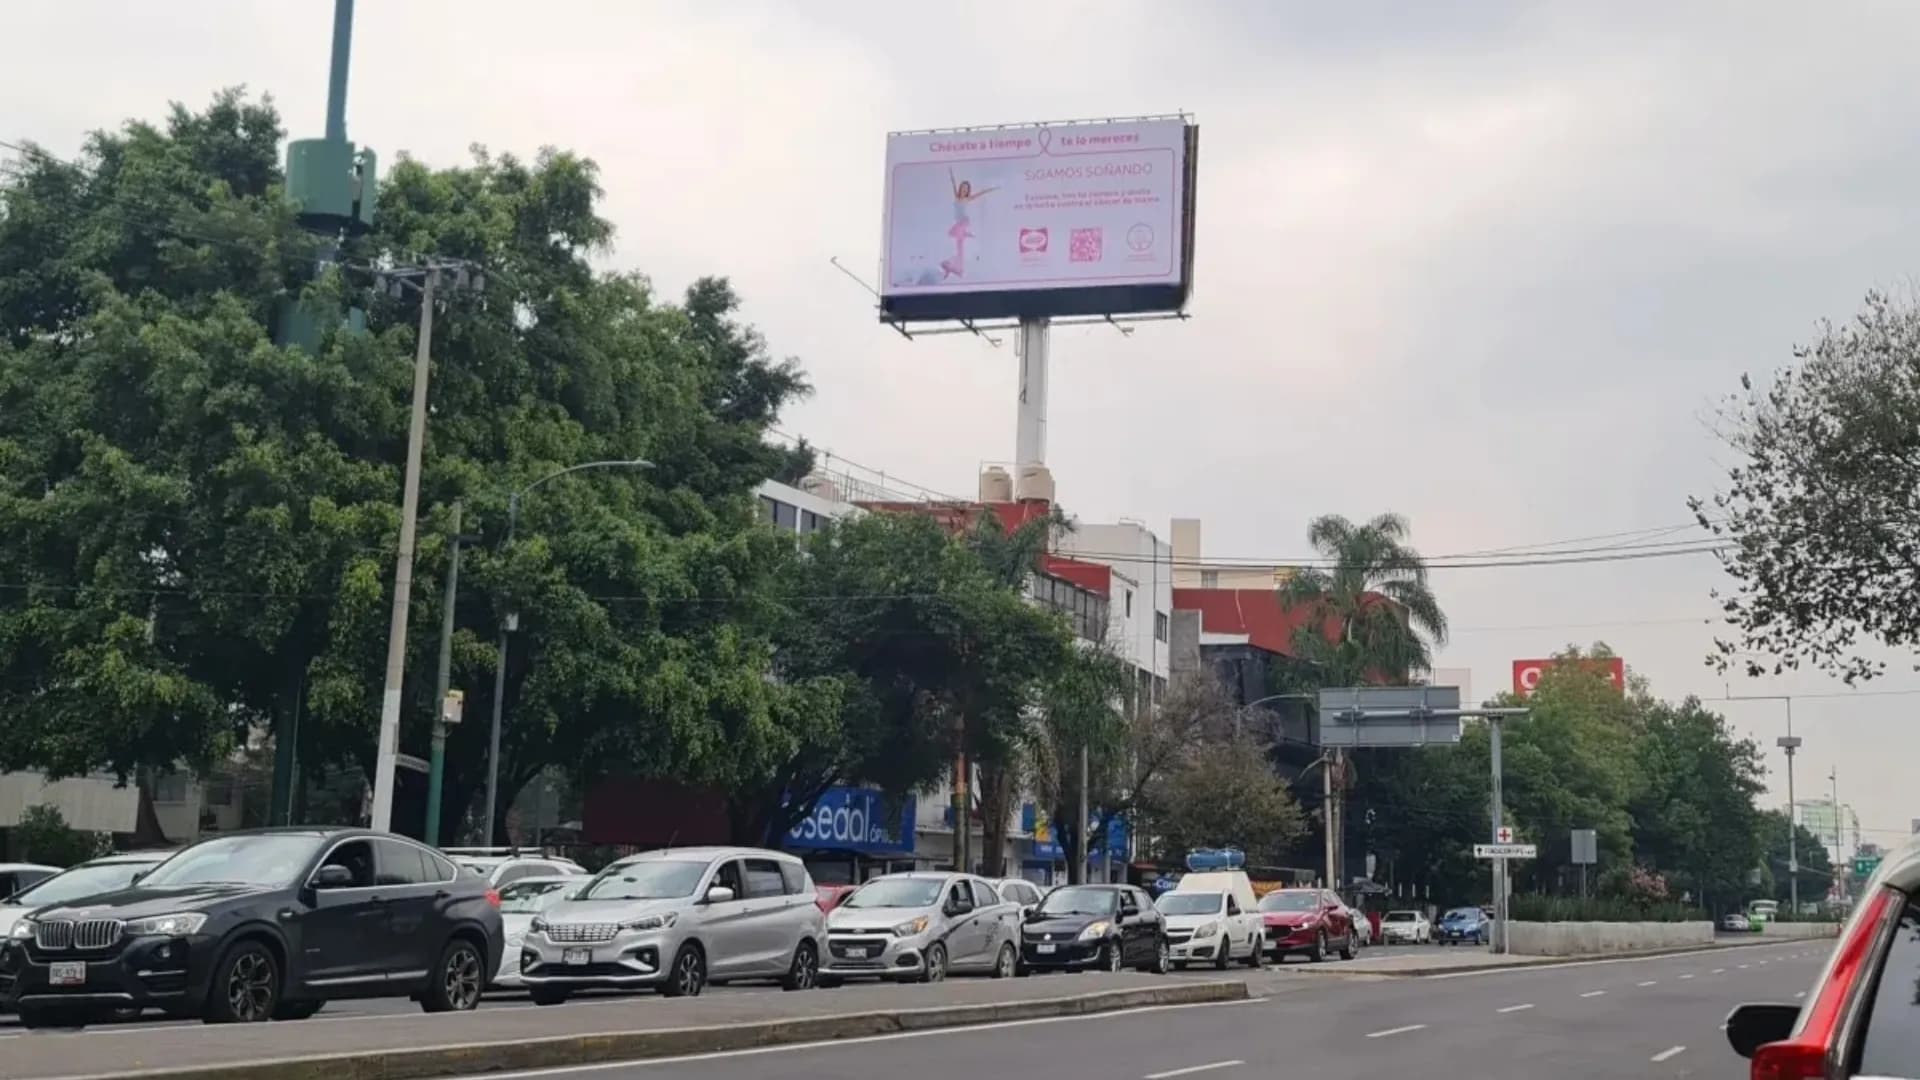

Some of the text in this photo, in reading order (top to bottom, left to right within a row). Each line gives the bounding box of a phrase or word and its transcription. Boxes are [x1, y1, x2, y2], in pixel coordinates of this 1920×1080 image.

[989, 138, 1032, 151] tiempo
[1061, 135, 1073, 145] te
[1089, 132, 1139, 144] mereces
[1024, 161, 1153, 181] SIGAMOS SOÑANDO
